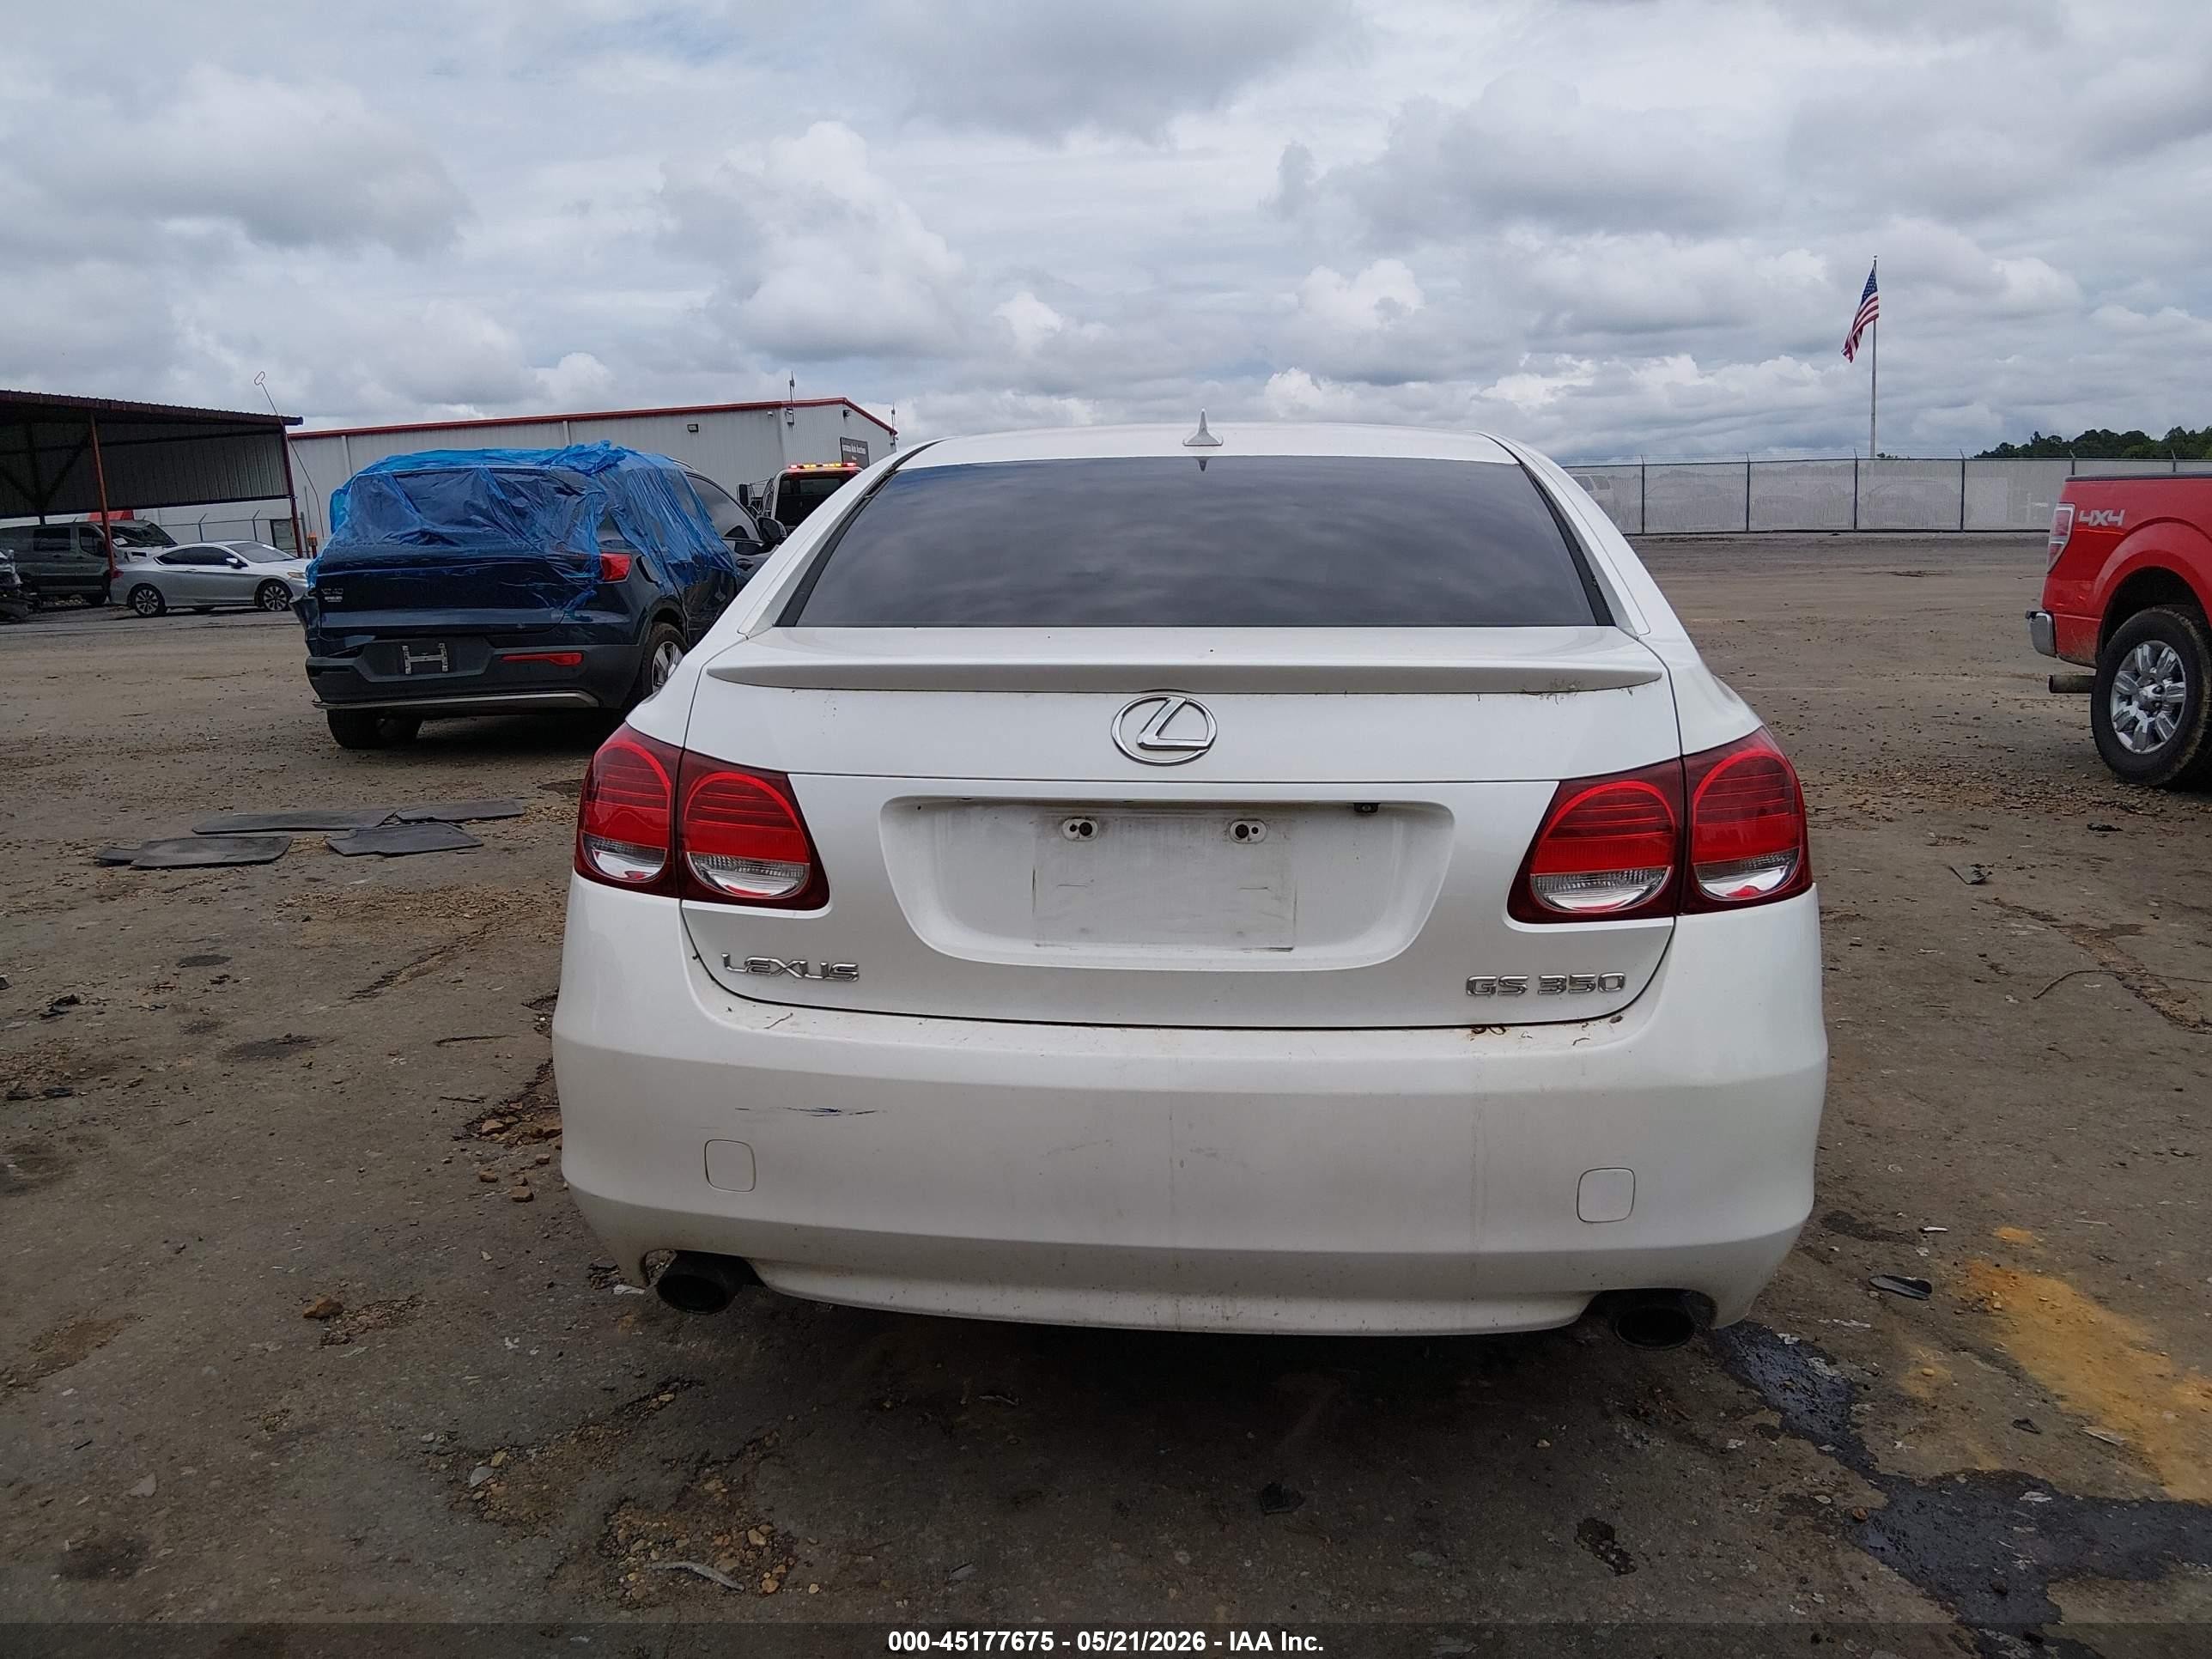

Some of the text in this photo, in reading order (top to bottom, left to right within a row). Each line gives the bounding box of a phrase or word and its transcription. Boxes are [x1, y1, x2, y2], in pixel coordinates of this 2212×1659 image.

[720, 952, 860, 983] LEXUS
[1465, 971, 1626, 997] GS 350
